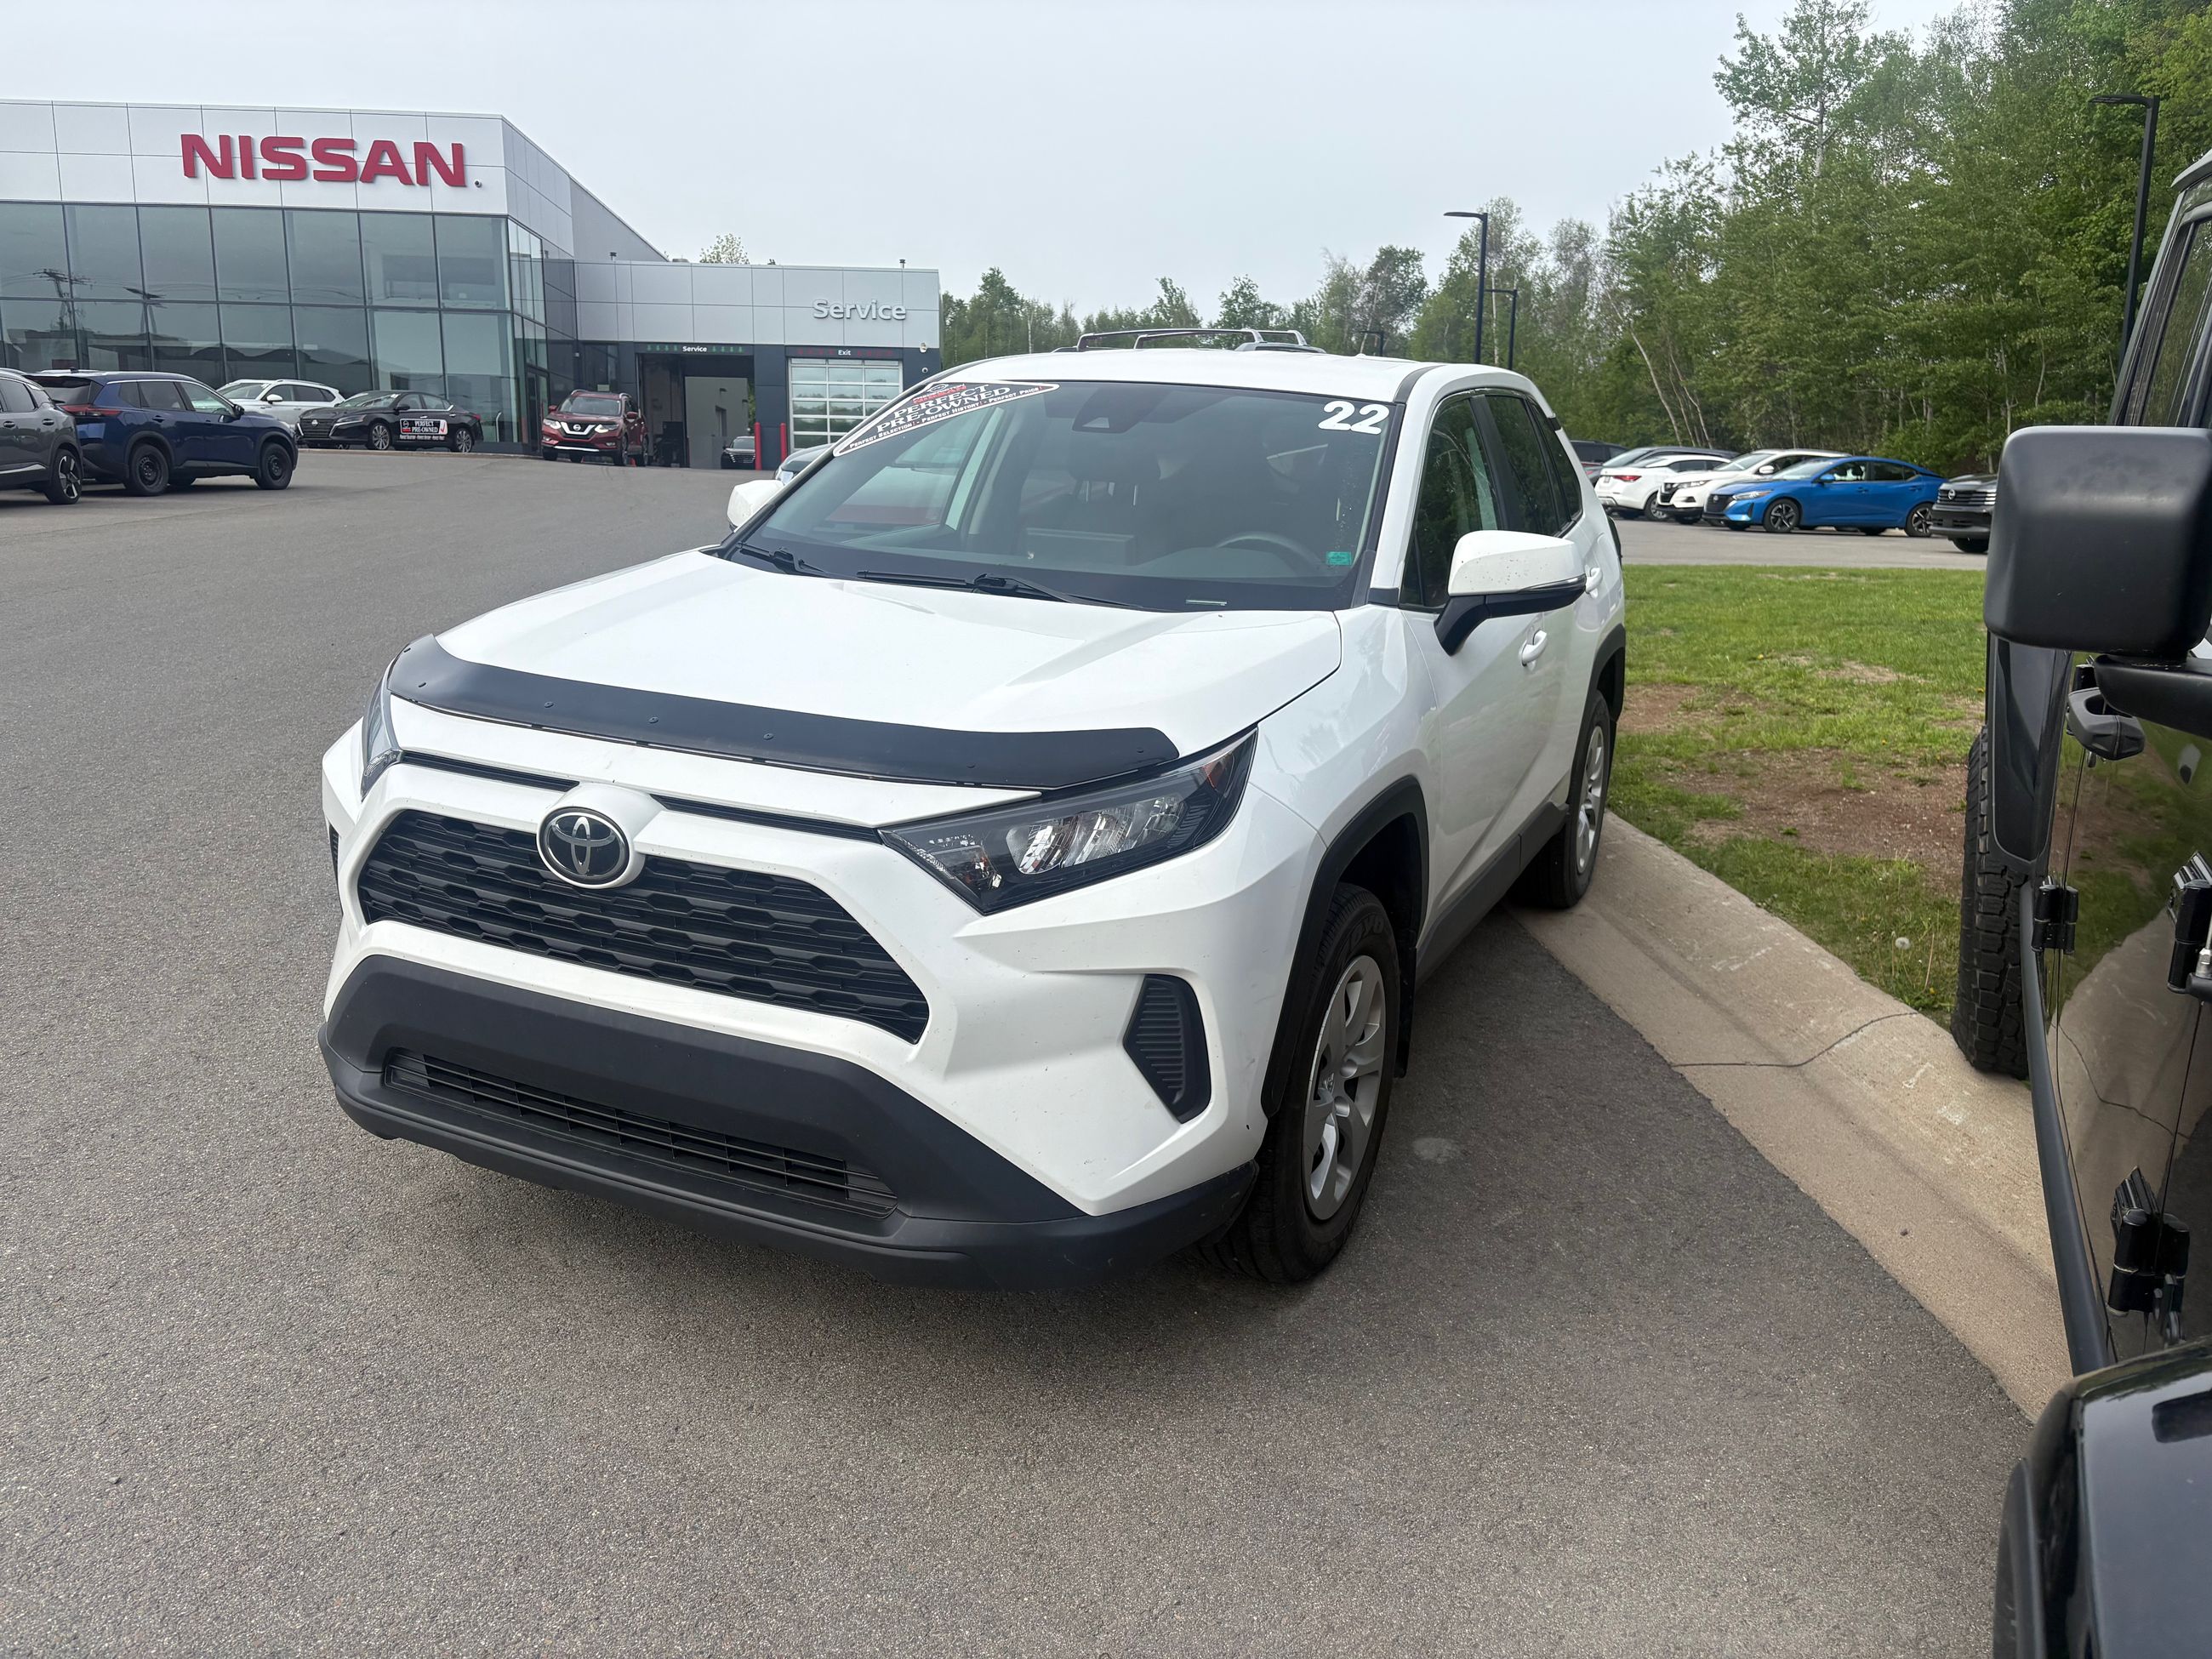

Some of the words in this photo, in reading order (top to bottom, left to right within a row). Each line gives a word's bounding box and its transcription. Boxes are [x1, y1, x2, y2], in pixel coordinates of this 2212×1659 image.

[180, 134, 466, 187] NISSAN
[812, 299, 907, 320] Service
[682, 345, 708, 353] Service
[838, 348, 852, 356] Exit
[876, 387, 1011, 433] PRE-OWNED
[893, 384, 989, 419] PERFECT
[1318, 400, 1390, 435] 22
